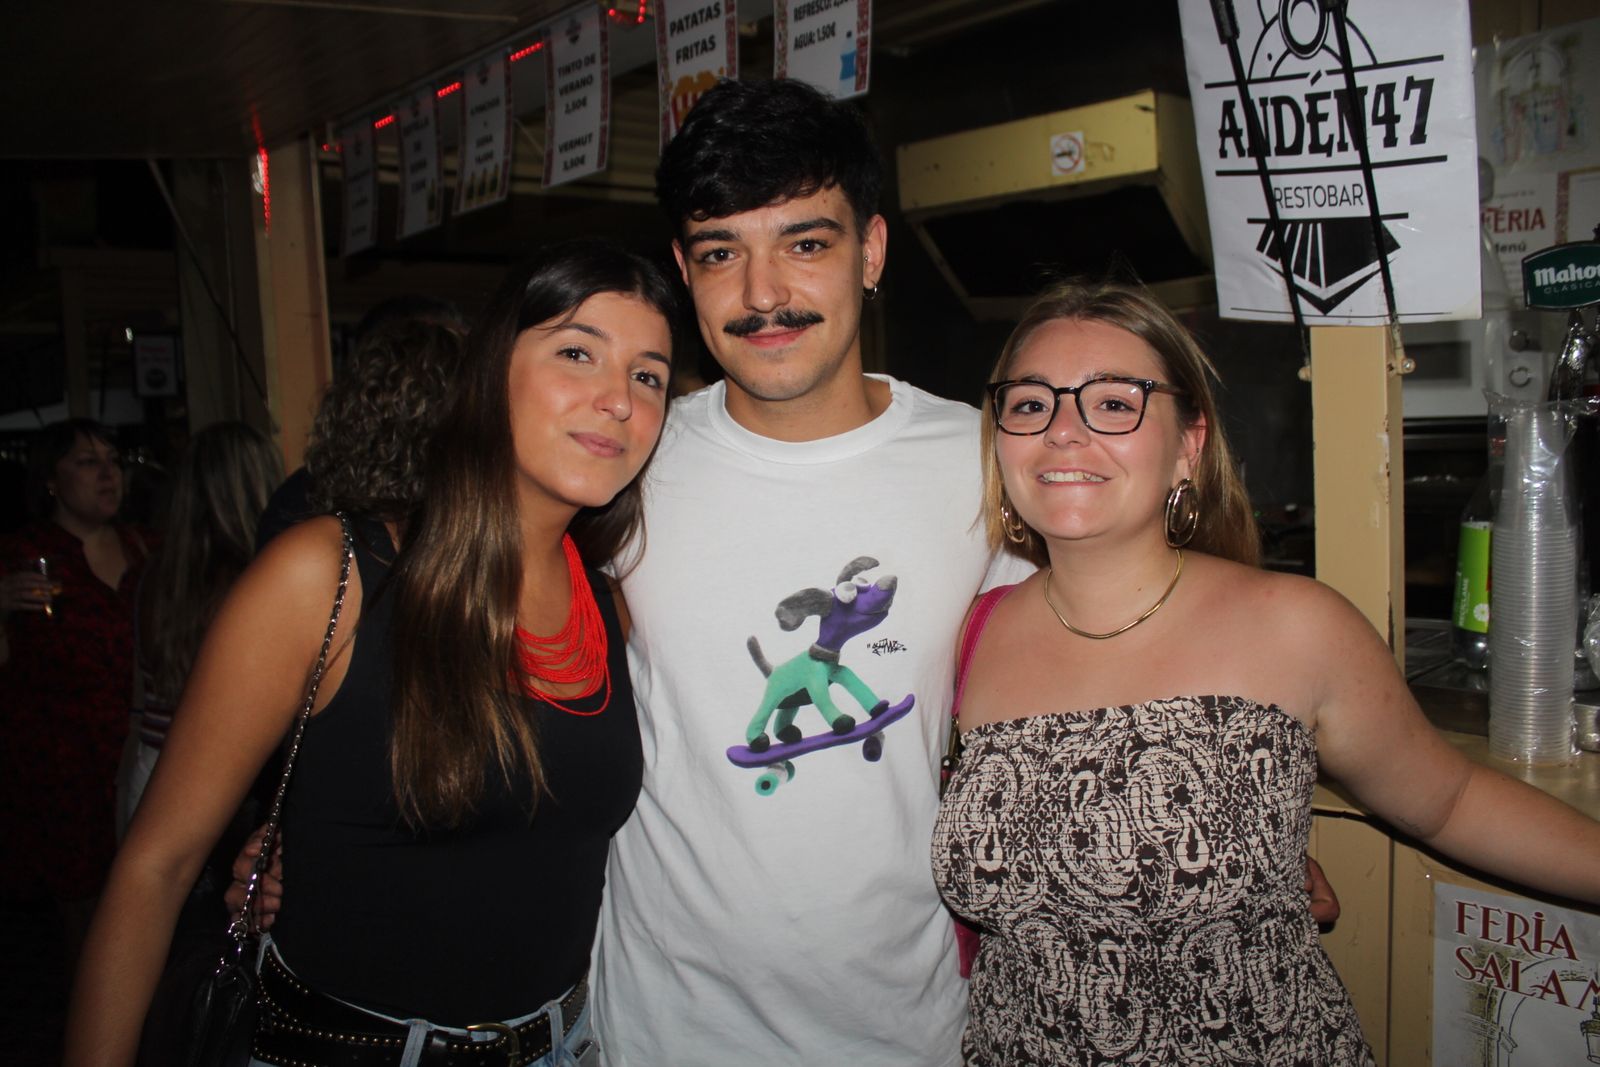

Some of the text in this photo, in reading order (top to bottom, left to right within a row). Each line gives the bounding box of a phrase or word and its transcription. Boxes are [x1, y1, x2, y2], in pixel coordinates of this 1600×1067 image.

[669, 2, 721, 37] PATATAS
[676, 35, 716, 64] FRITAS
[794, 31, 816, 50] AGUA:
[557, 53, 595, 78] TINTO DE
[558, 75, 593, 96] VERANO
[1218, 70, 1434, 158] ANDÉN47
[558, 133, 593, 153] VERMUT
[1273, 183, 1364, 209] RESTOBAR
